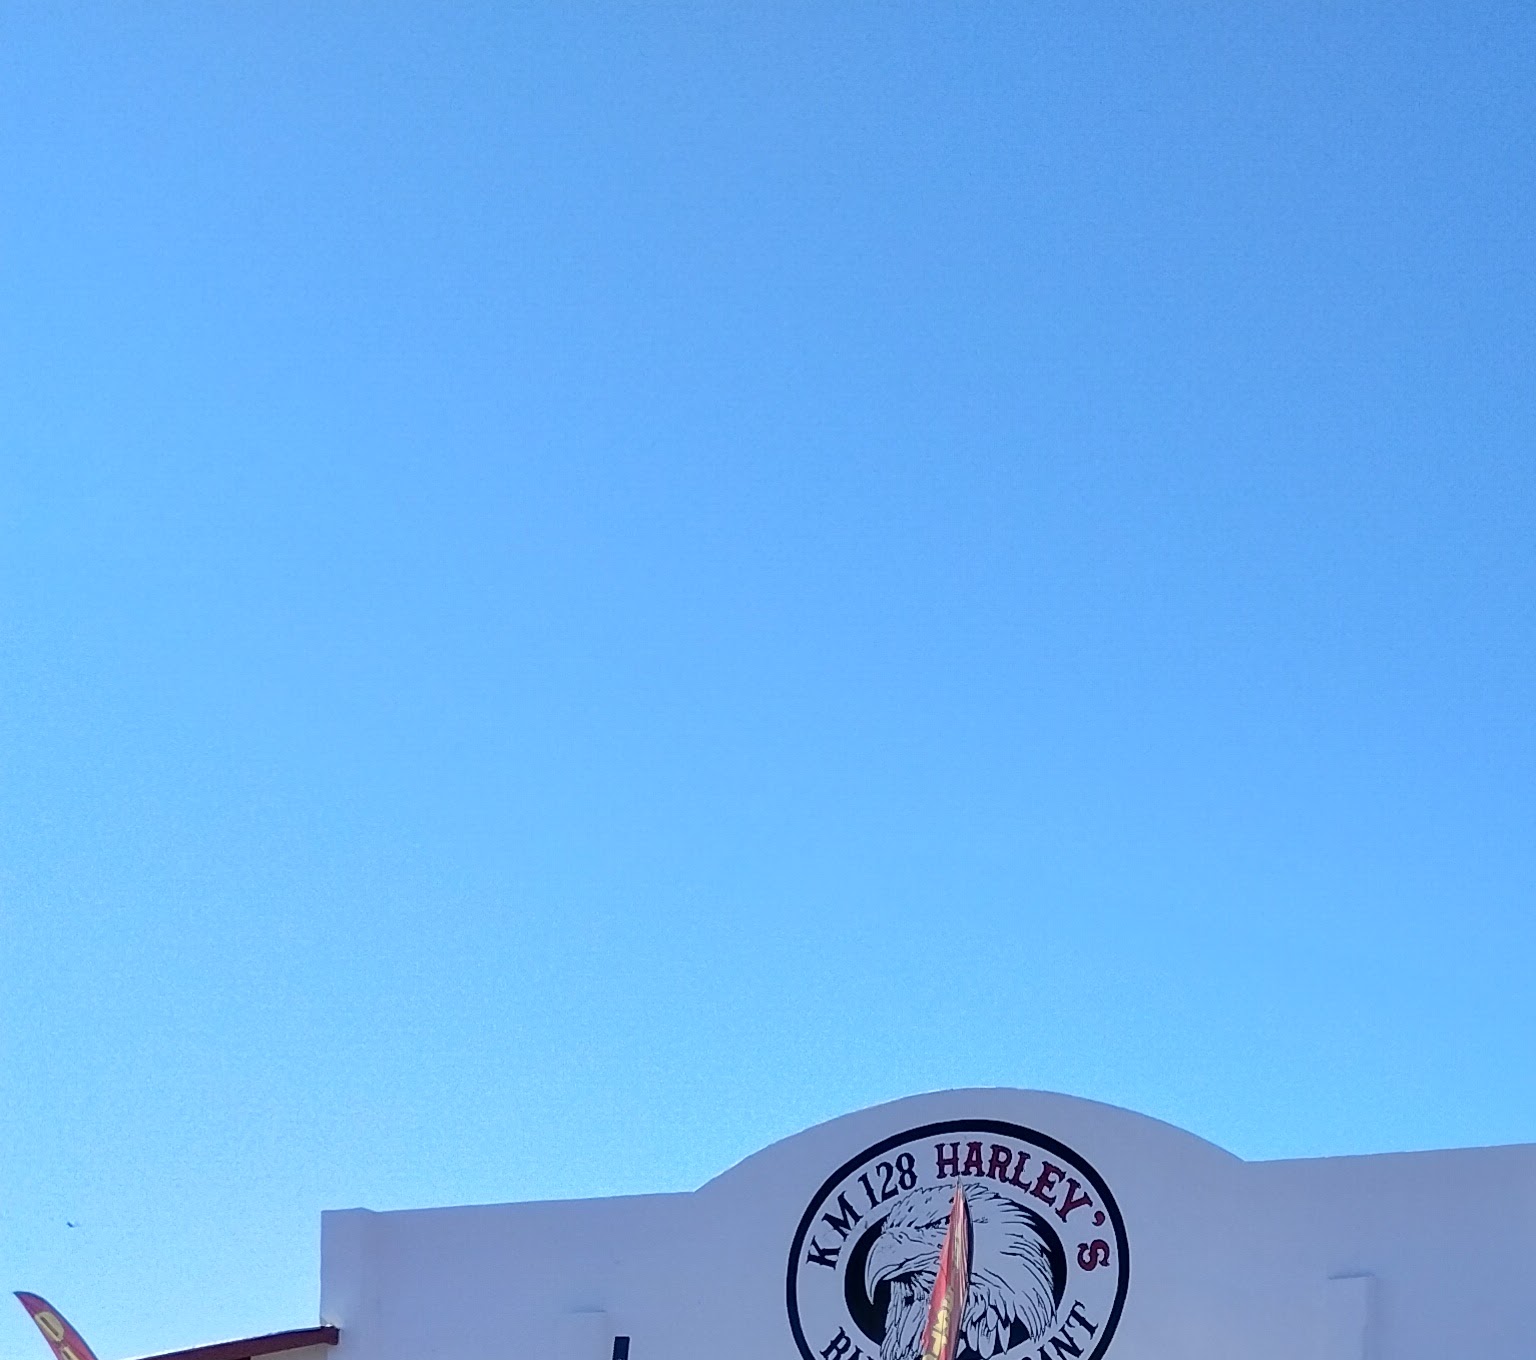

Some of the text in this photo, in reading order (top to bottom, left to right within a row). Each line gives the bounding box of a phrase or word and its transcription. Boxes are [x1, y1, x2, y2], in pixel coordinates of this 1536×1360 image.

[807, 1141, 1110, 1272] KM 128 HARLEY'S
